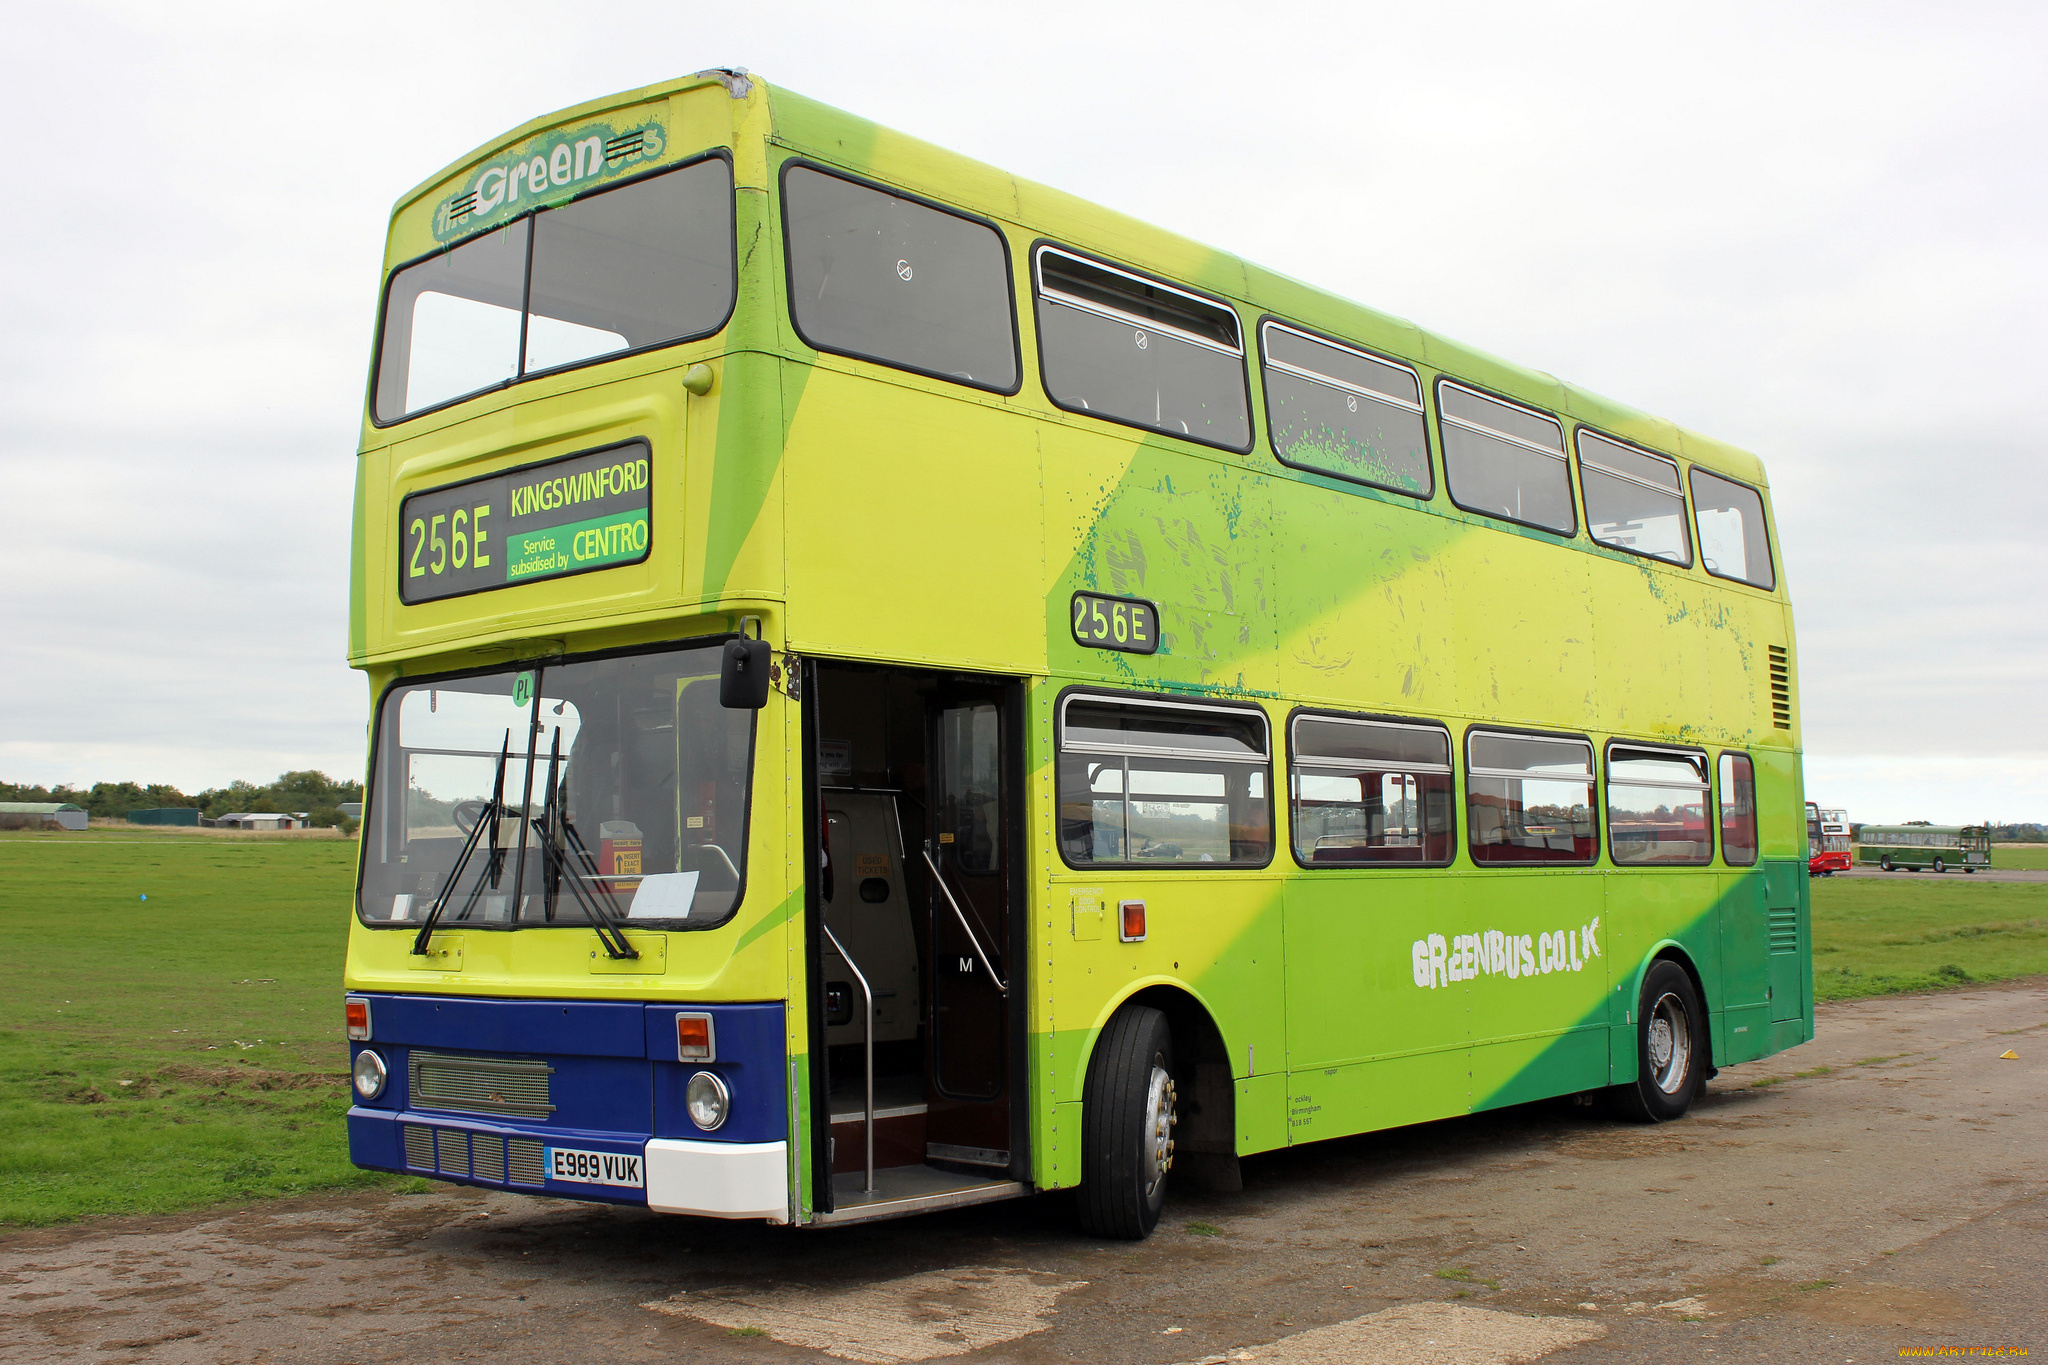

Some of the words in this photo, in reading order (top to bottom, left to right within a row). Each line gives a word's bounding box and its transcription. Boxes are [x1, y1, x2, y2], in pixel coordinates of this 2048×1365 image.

[472, 135, 604, 216] Green
[607, 128, 663, 169] bus
[511, 458, 649, 518] KINGSWINFORD
[409, 504, 490, 578] 256E
[523, 536, 556, 556] Service
[572, 519, 648, 562] CENTRO
[510, 553, 556, 577] subsidised
[557, 551, 569, 571] by
[1074, 597, 1147, 644] 256E
[517, 679, 528, 700] PL
[858, 866, 888, 874] TICKETS
[862, 856, 882, 865] USED
[1069, 887, 1104, 896] EMERGENCY
[1079, 897, 1095, 905] DOOR
[1075, 905, 1101, 913] CONTROL
[959, 957, 973, 972] M
[1291, 1105, 1321, 1115] Birmingham
[554, 1151, 600, 1178] E989
[603, 1155, 639, 1182] VUK
